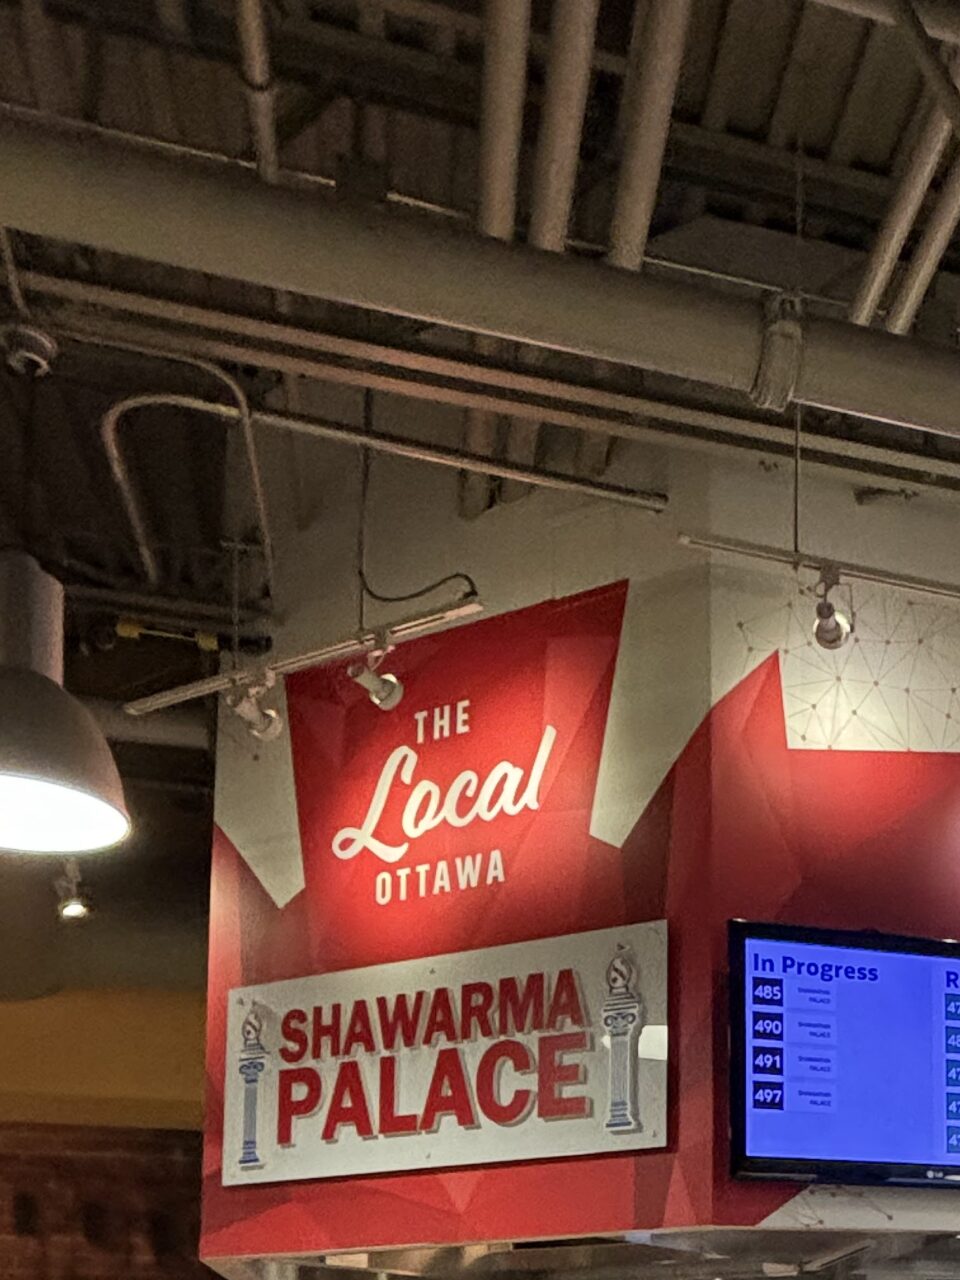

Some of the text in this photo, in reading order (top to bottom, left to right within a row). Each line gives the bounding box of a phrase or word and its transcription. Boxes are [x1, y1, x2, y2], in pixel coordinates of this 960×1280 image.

[413, 699, 471, 744] THE
[331, 725, 558, 864] Local
[374, 848, 506, 906] OTTAWA
[753, 952, 879, 983] In Progress
[754, 984, 782, 1000] 485
[278, 967, 592, 1064] SHAWARMA
[754, 1019, 783, 1035] 490
[754, 1053, 781, 1069] 491
[276, 1032, 594, 1147] PALACE
[754, 1088, 783, 1104] 497
